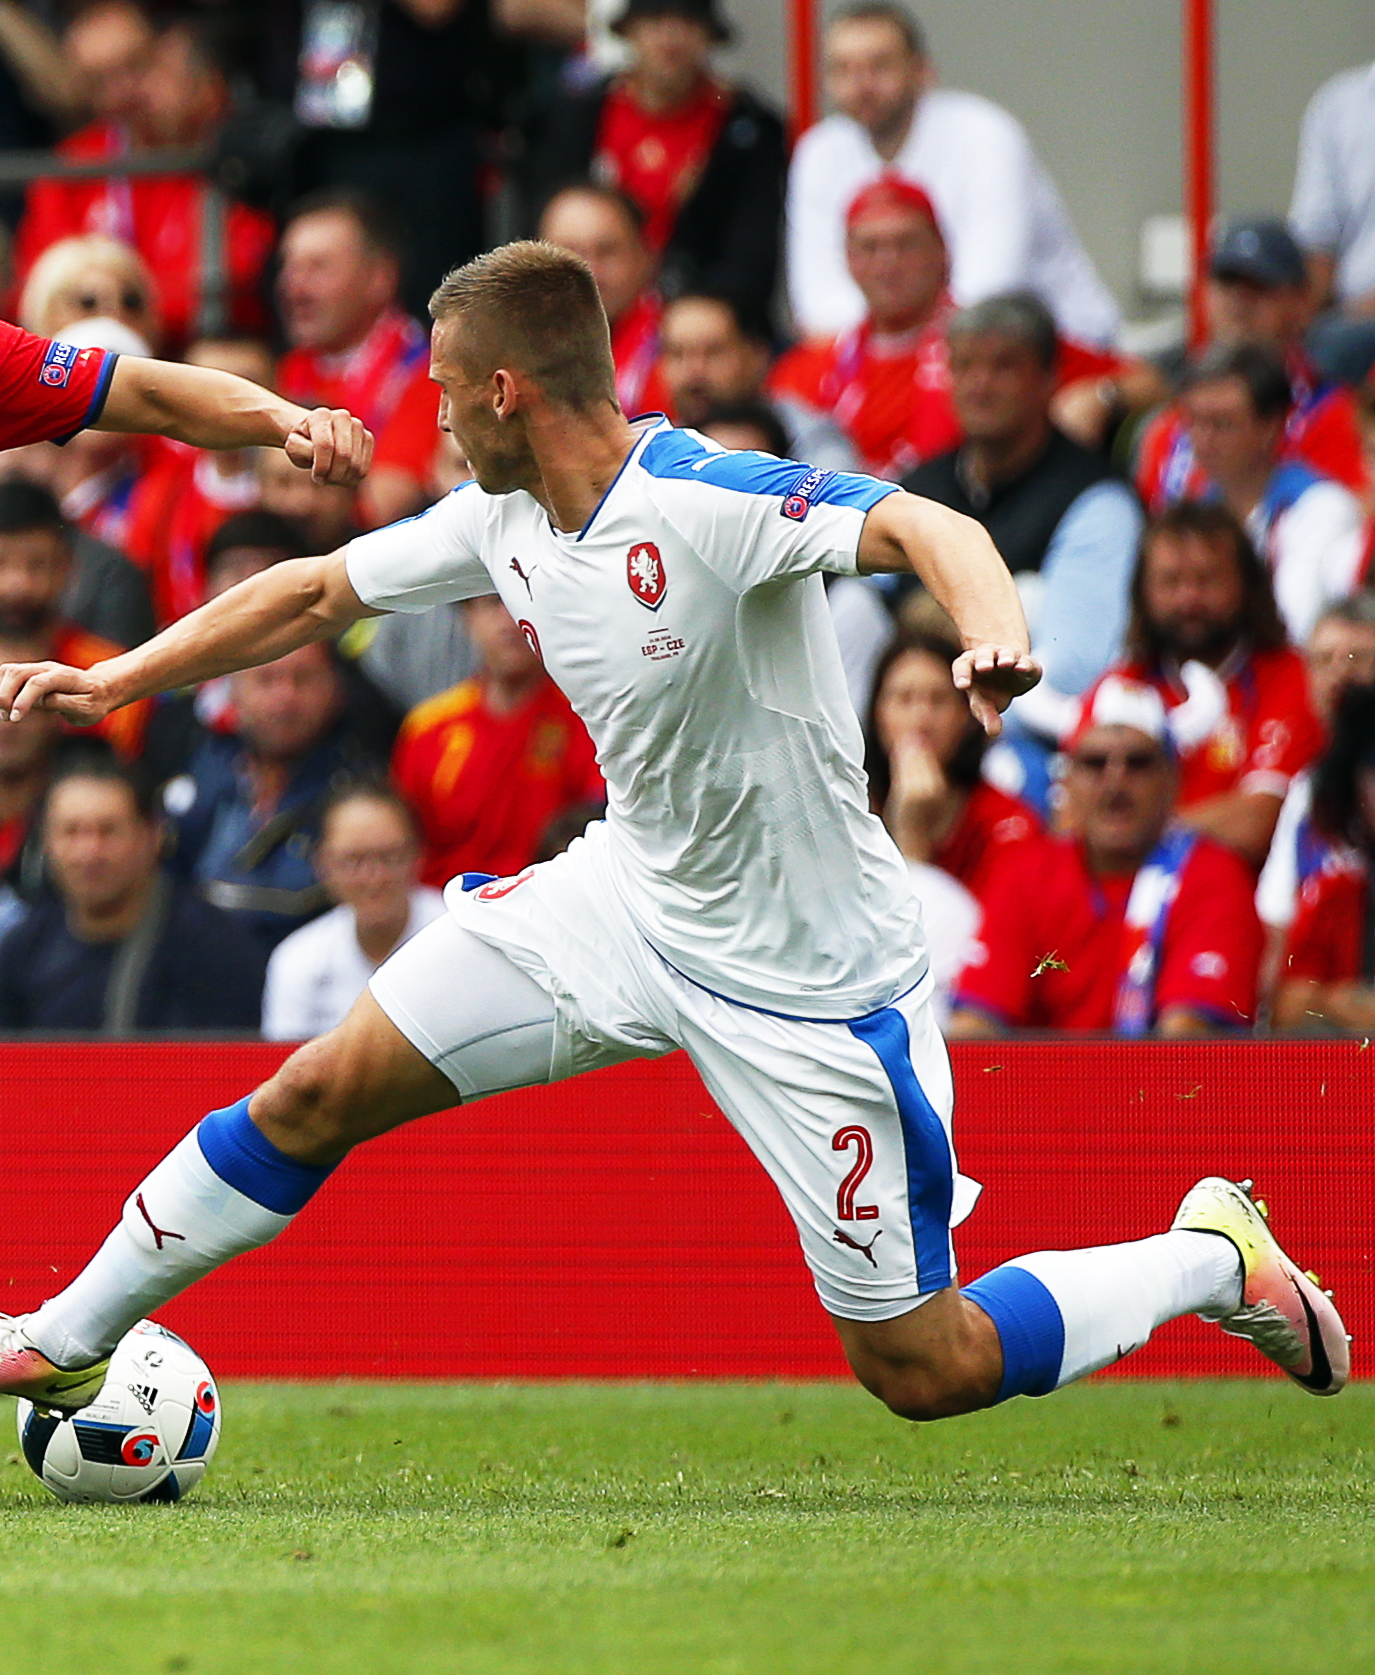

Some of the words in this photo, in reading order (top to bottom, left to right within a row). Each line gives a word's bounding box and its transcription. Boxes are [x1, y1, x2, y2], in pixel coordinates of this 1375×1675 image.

[52, 342, 71, 365] RES
[641, 644, 658, 657] ESP
[666, 638, 685, 651] CZE
[831, 1124, 880, 1221] 2
[127, 1383, 156, 1416] adidas
